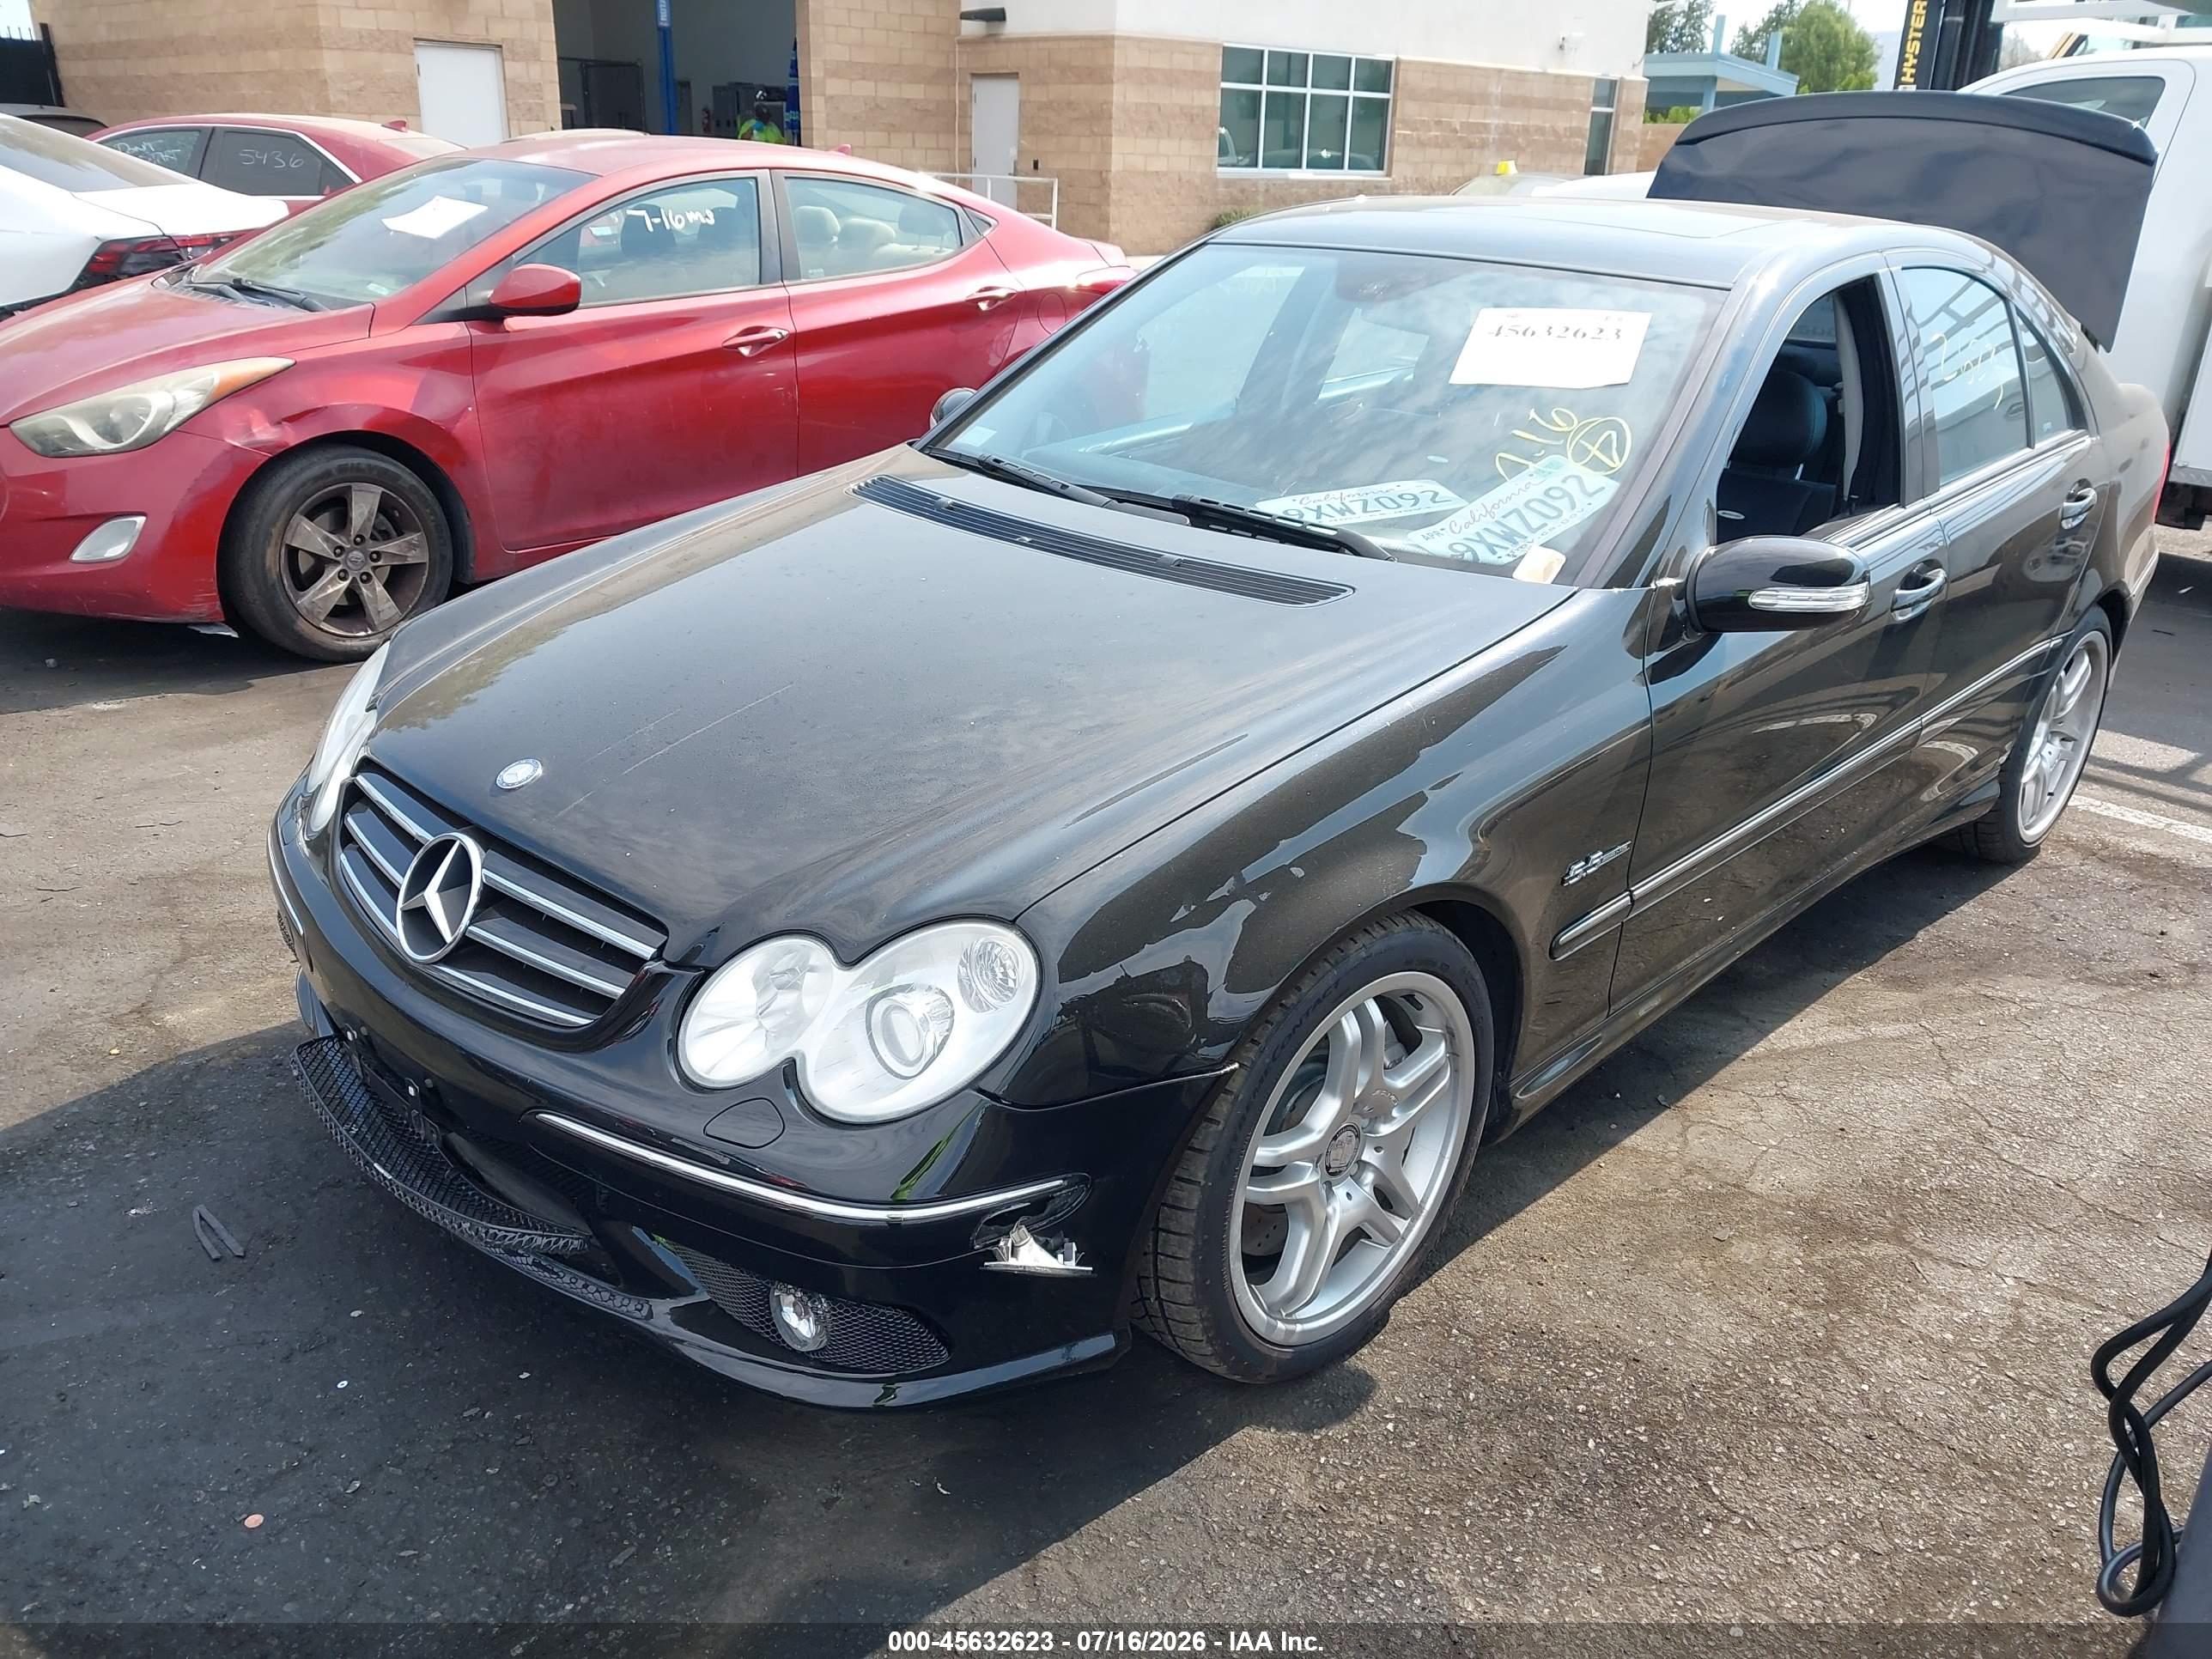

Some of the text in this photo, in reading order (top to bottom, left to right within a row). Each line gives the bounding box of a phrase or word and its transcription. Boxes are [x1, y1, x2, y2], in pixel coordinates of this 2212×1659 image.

[1900, 0, 1928, 83] HYSTER
[239, 149, 304, 168] 5436
[1487, 324, 1622, 341] 45632623
[1282, 489, 1452, 521] 9XWZ092
[1448, 474, 1607, 563] 9XWZ092
[1449, 478, 1546, 536] California
